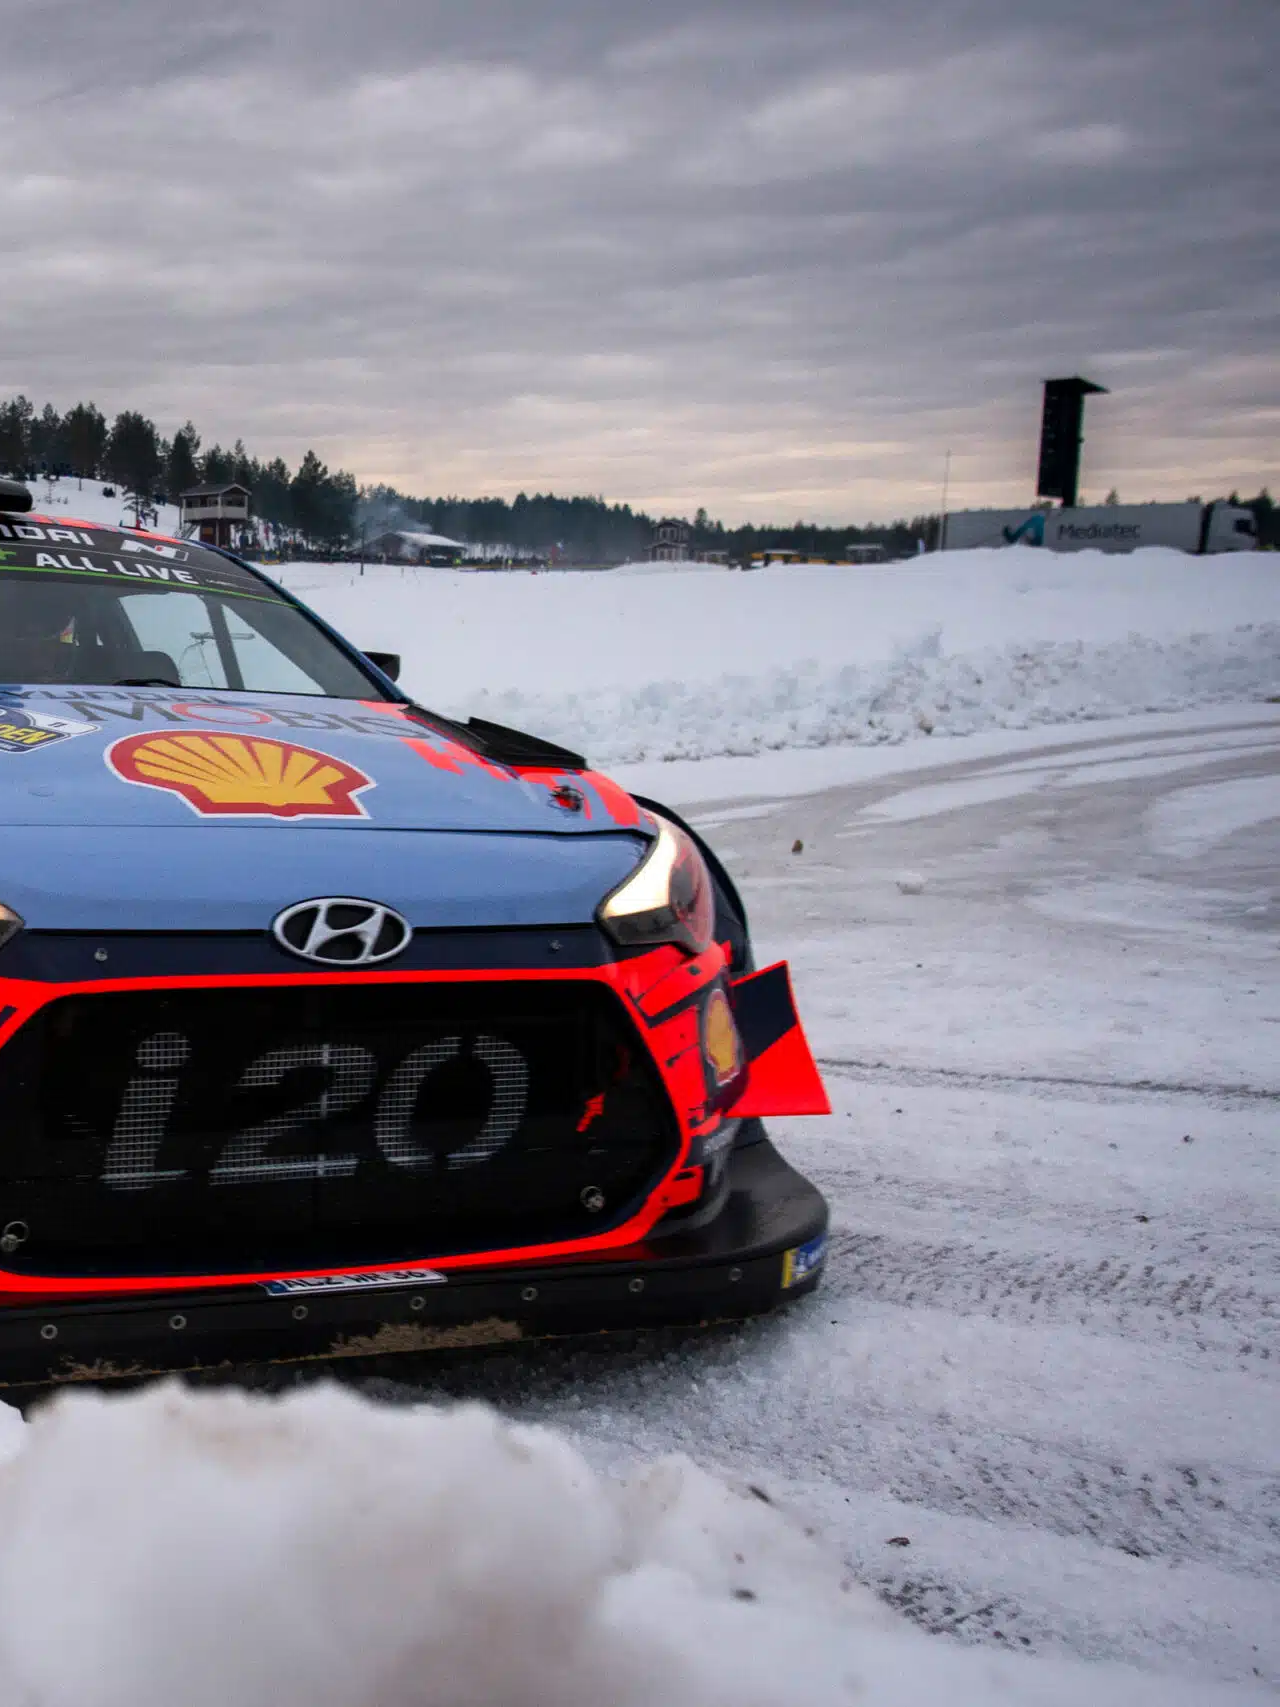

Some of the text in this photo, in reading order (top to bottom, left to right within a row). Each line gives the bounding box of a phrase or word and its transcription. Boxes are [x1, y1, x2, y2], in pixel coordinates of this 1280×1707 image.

[36, 552, 108, 573] ALL
[113, 560, 200, 585] LIVE
[62, 700, 431, 739] MOBIS
